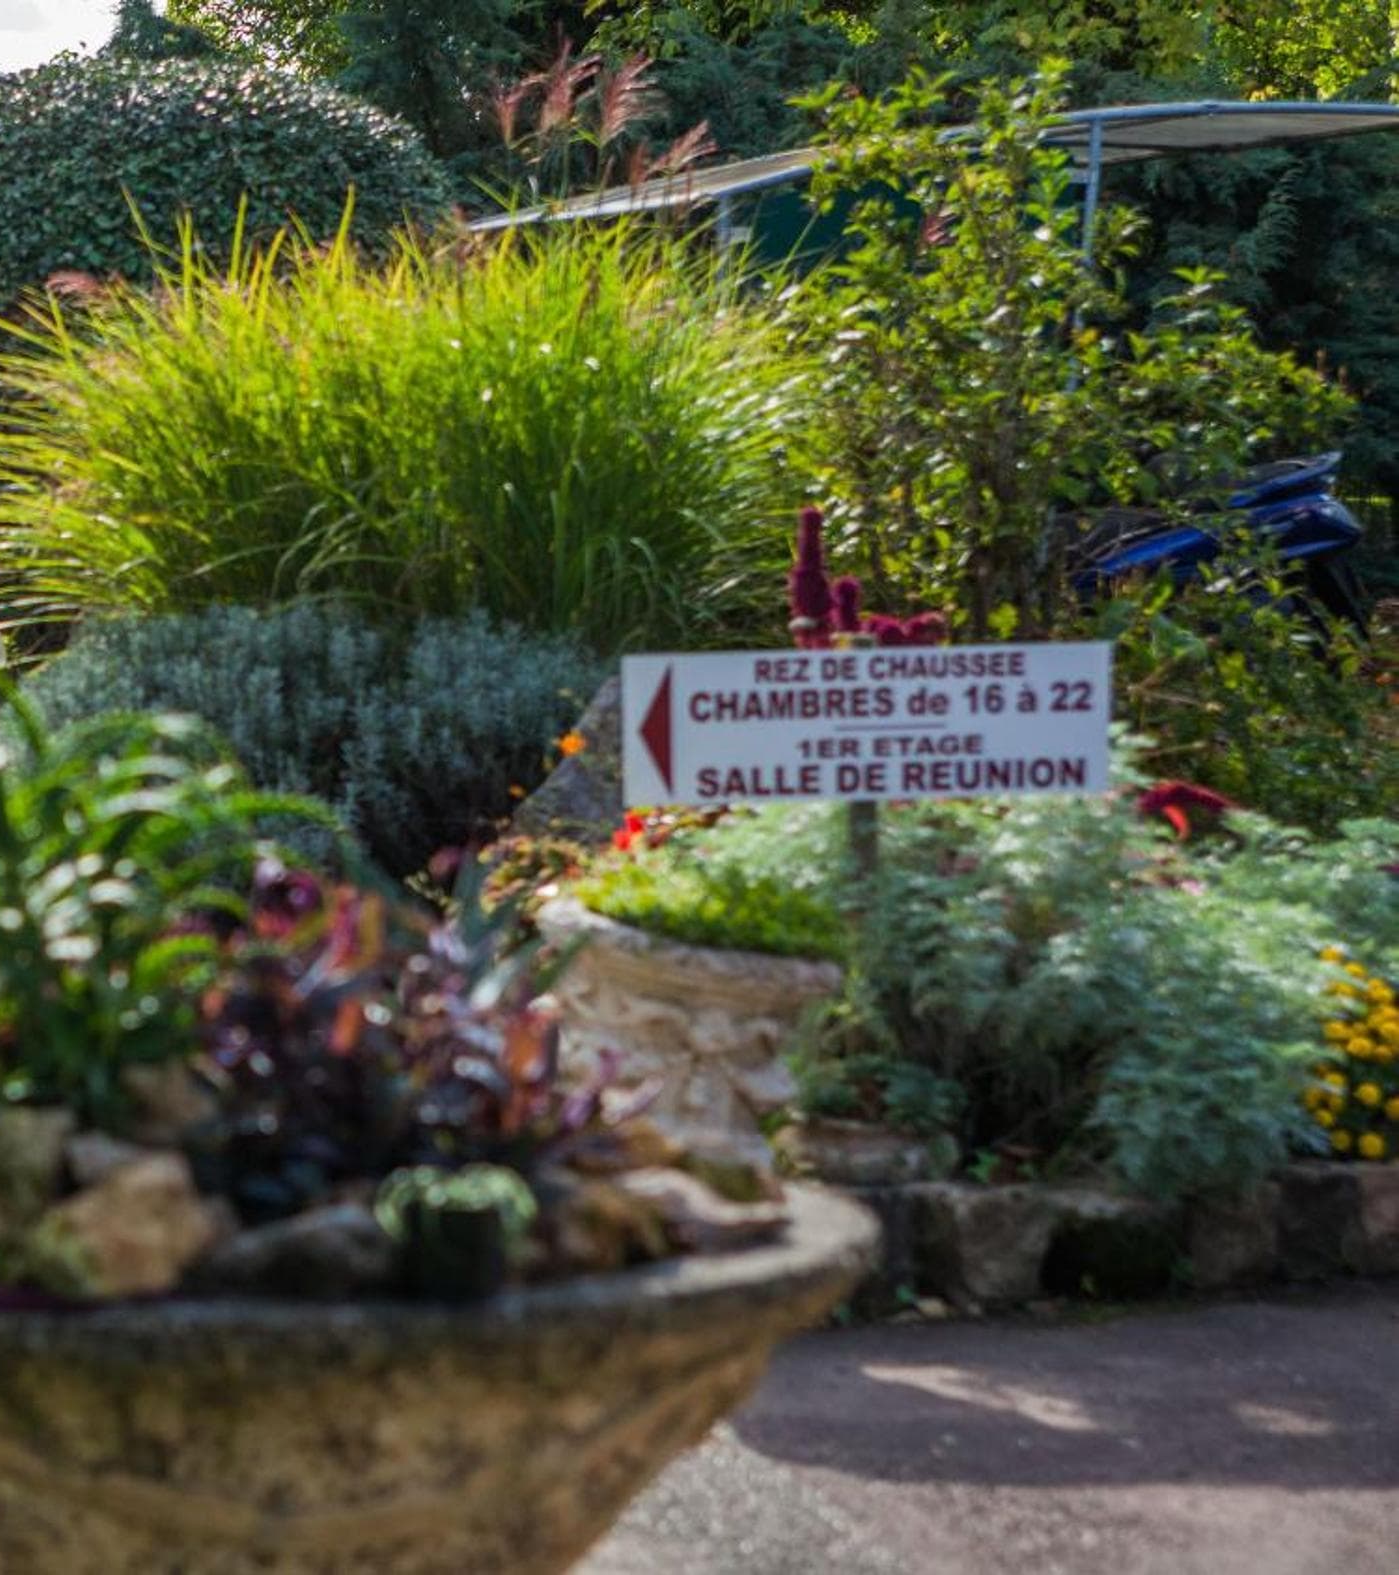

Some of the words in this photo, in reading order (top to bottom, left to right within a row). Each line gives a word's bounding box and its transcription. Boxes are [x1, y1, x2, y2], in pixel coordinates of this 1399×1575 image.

[754, 657, 812, 684] REZ
[821, 655, 859, 682] DE
[868, 651, 1028, 681] CHAUSSEE
[688, 686, 896, 723] CHAMBRES
[906, 685, 951, 716] de
[963, 682, 1007, 715] 16
[1016, 680, 1040, 714] à
[1049, 678, 1095, 713] 22
[797, 736, 861, 760] 1ER
[872, 732, 984, 758] ETAGE
[697, 764, 823, 799] SALLE
[835, 761, 889, 795] DE
[902, 756, 1089, 793] REUNION
